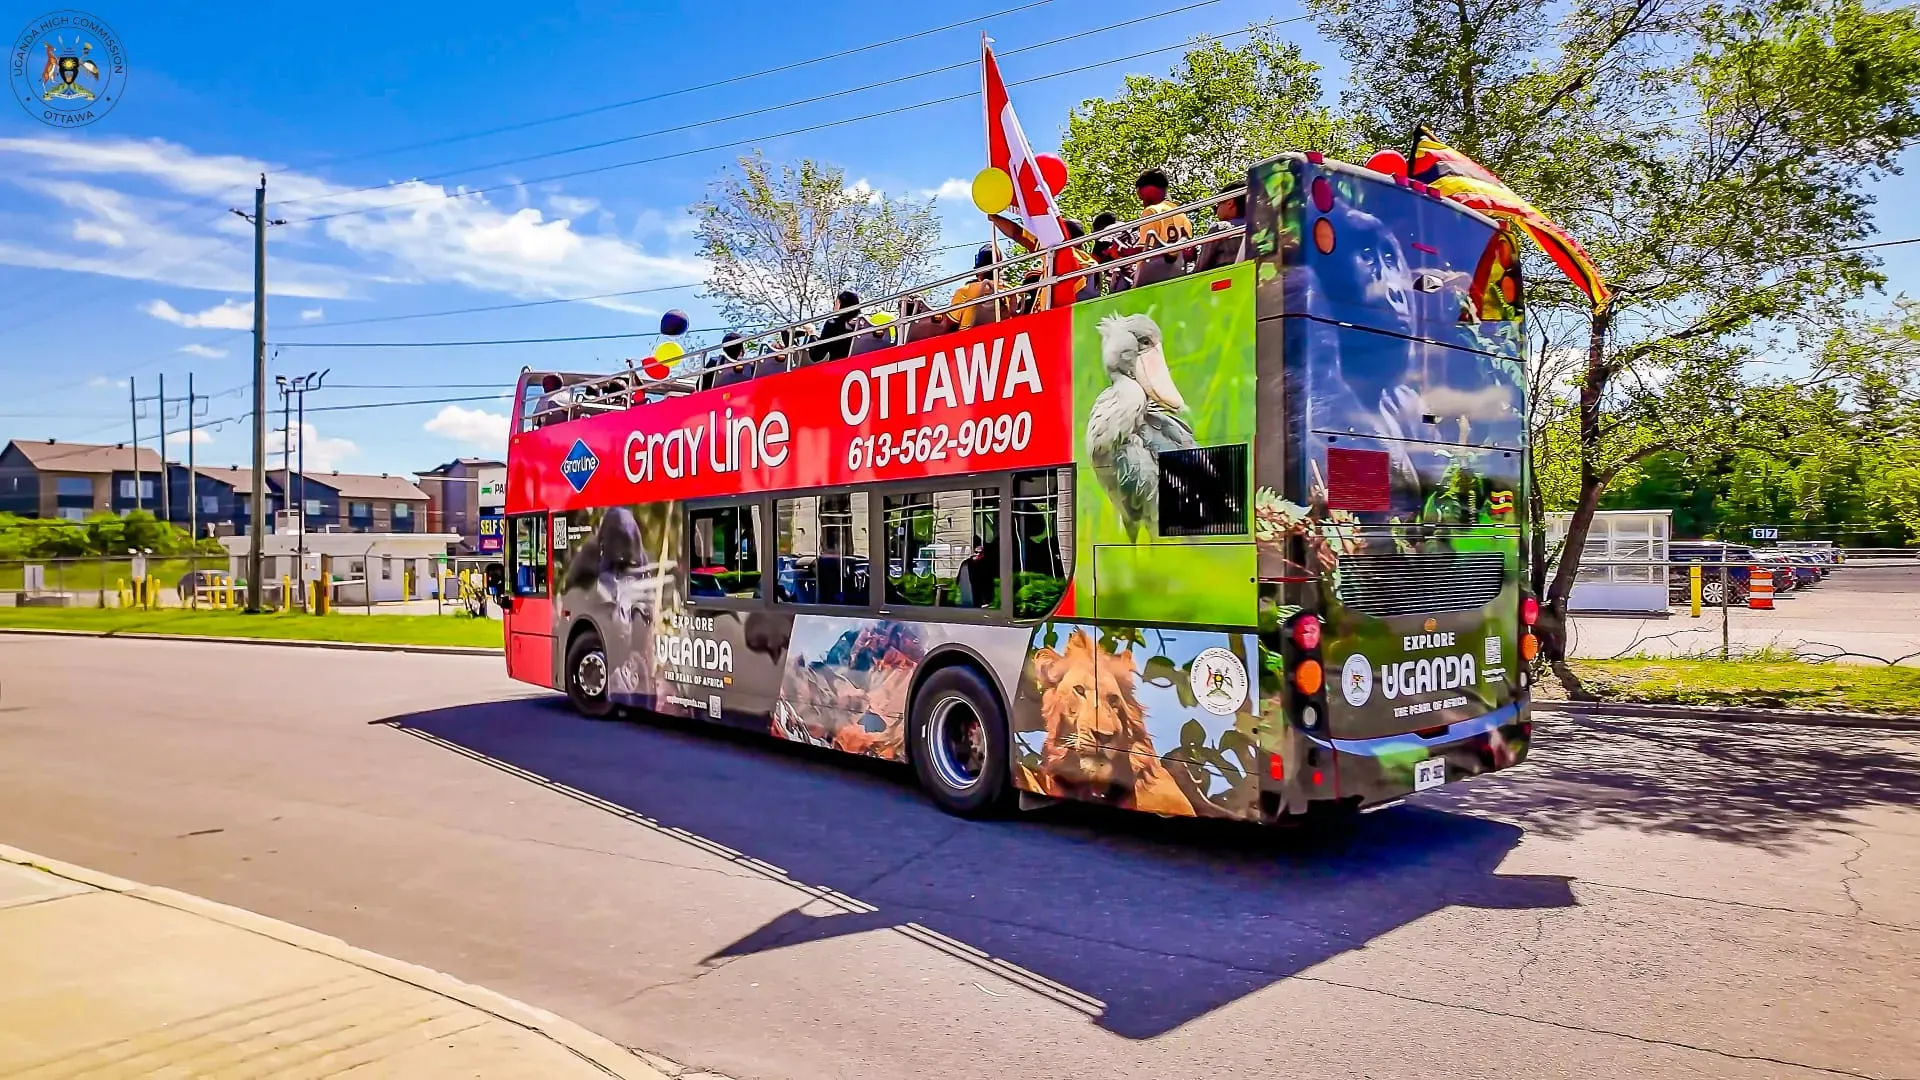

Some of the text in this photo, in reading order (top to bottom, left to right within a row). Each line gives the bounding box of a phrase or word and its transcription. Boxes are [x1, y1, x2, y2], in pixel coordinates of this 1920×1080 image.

[840, 332, 1043, 426] OTTAWA
[624, 407, 790, 484] Gray Line
[848, 411, 1032, 471] 613-562-9090
[480, 519, 497, 535] SELF
[672, 615, 714, 632] EXPLORE
[656, 634, 733, 673] UGANDA
[1403, 631, 1456, 651] EXPLORE
[664, 670, 675, 681] THE
[694, 675, 702, 685] OF
[702, 676, 724, 689] AFRICA
[1381, 653, 1476, 700] UGANDA
[1432, 700, 1443, 710] OF
